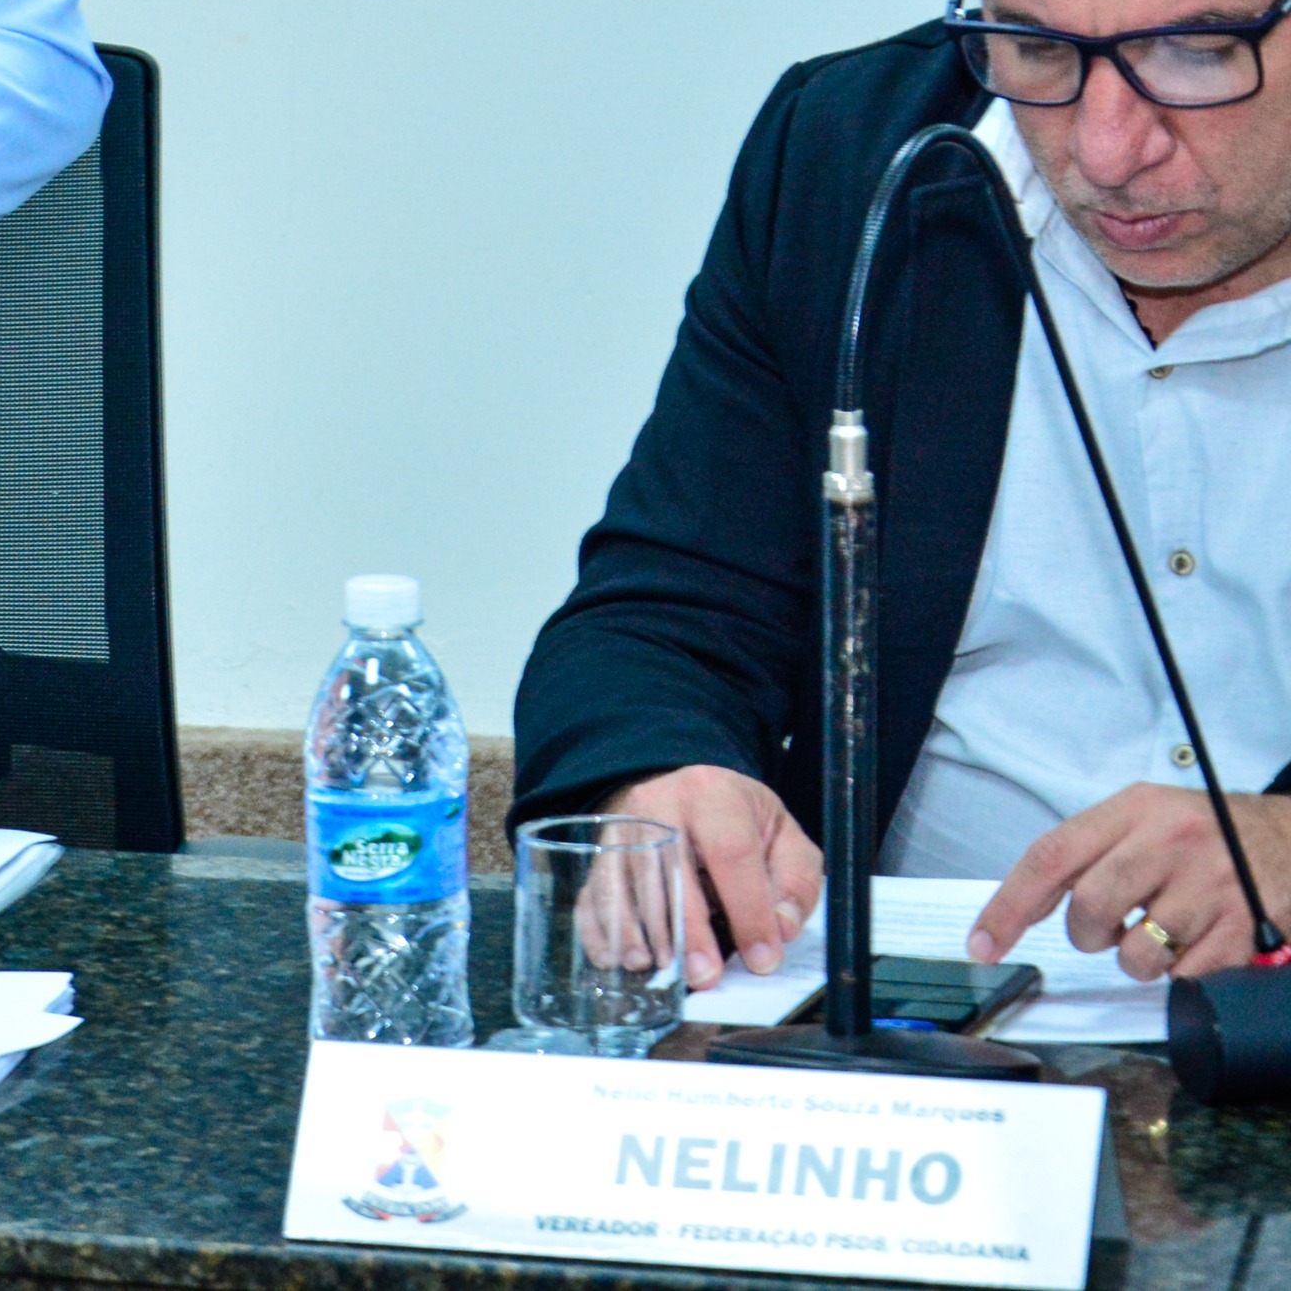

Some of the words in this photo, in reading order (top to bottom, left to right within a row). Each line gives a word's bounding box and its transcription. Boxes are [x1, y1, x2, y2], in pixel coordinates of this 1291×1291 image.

[341, 849, 403, 871] Negra
[354, 838, 410, 855] Serra
[667, 1088, 794, 1111] Humberto
[803, 1094, 881, 1116] Souza
[891, 1099, 1006, 1123] Marques
[614, 1133, 964, 1206] NELINHO
[534, 1215, 660, 1238] VEREADOR
[678, 1223, 818, 1248] FEDERAÇÃO
